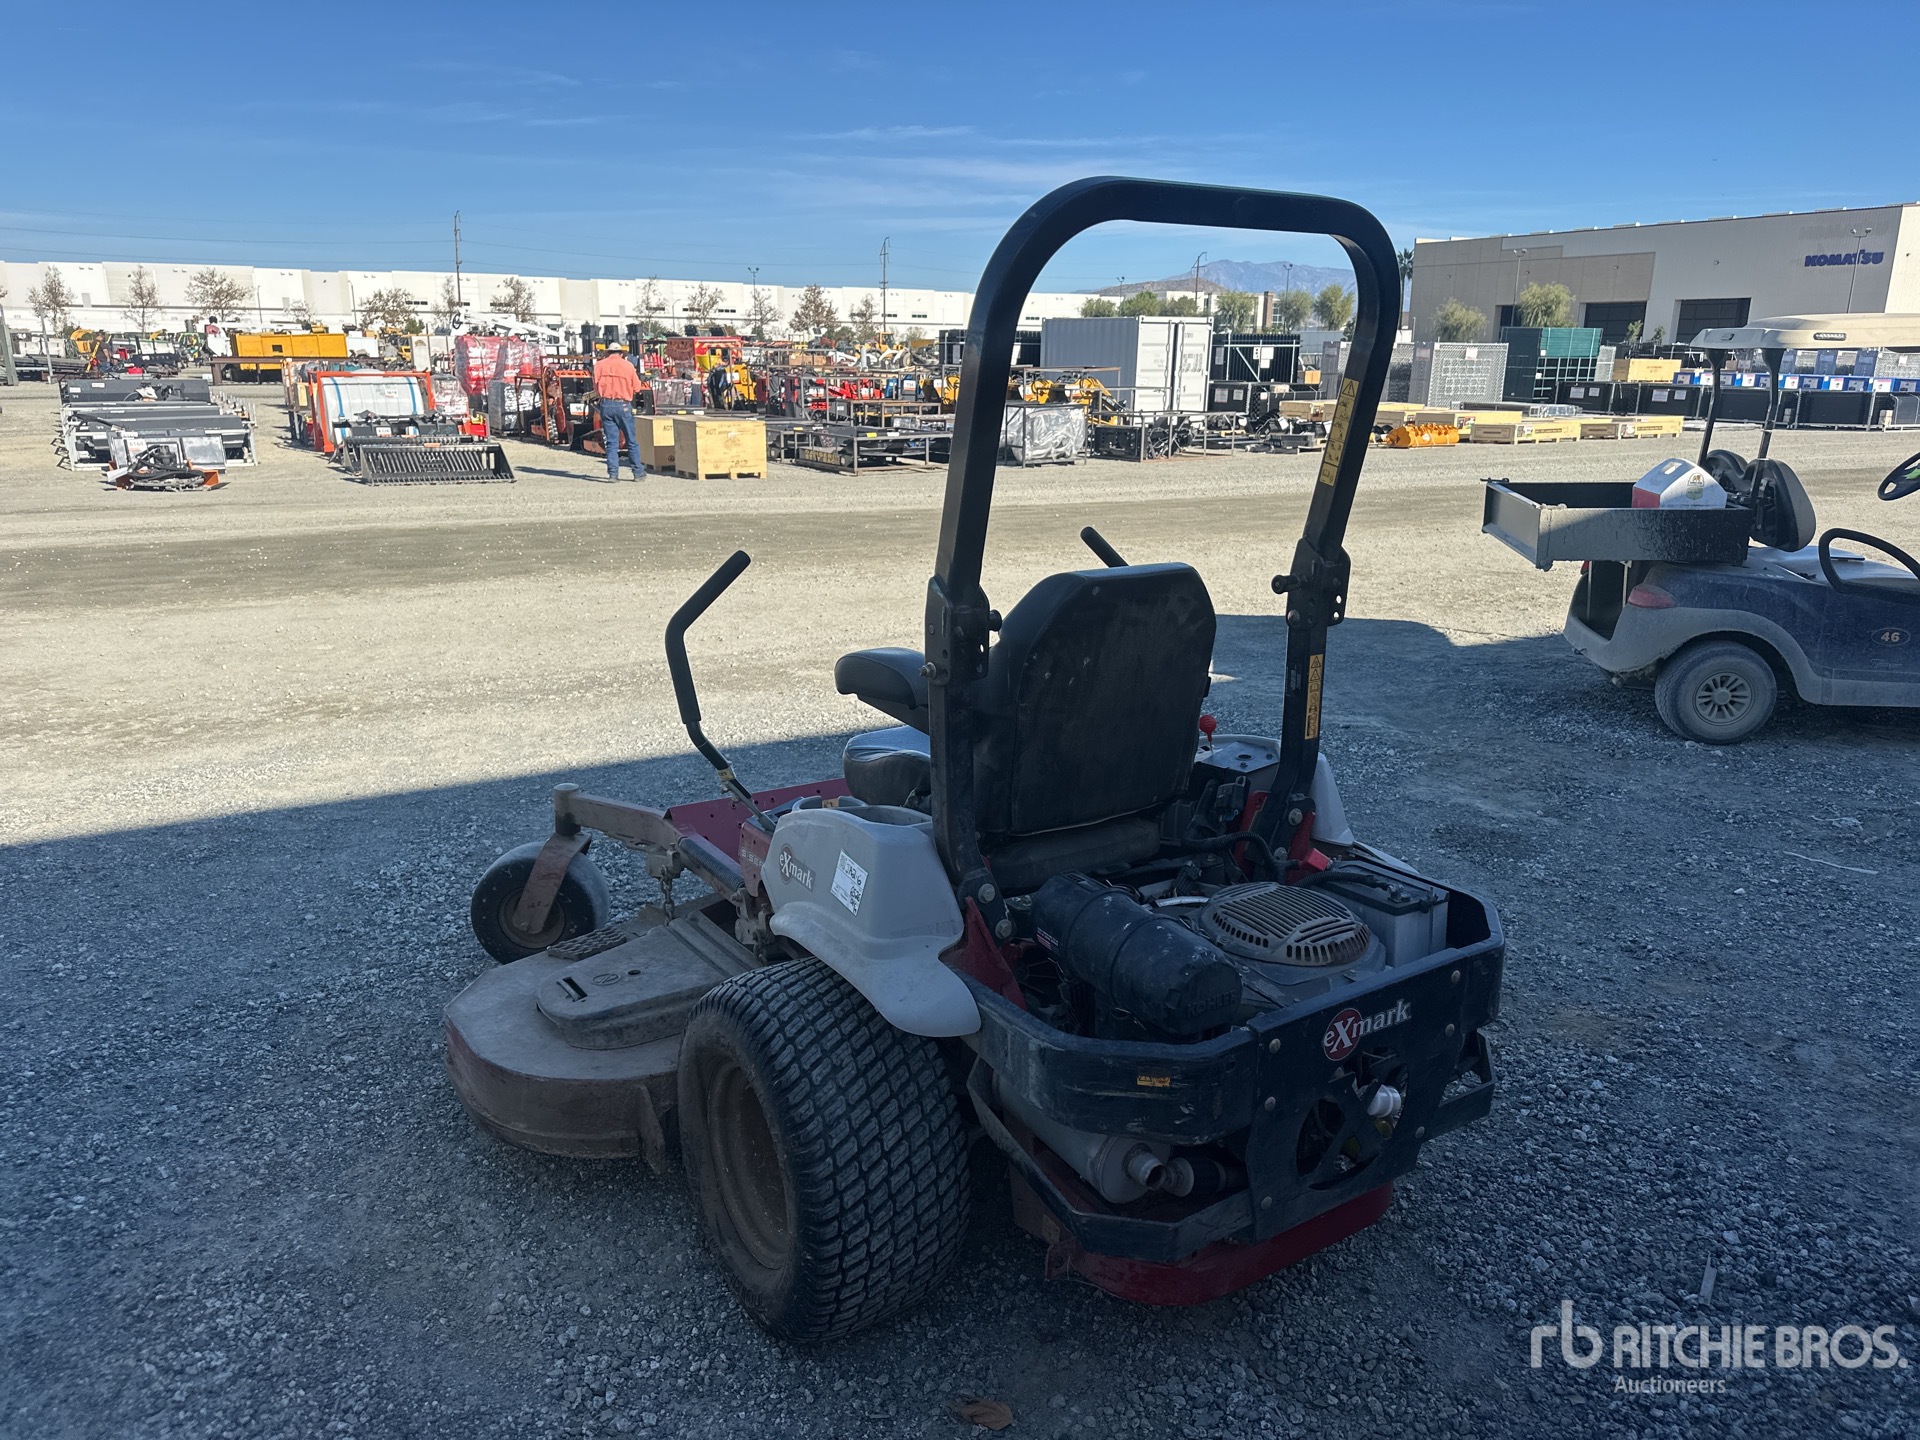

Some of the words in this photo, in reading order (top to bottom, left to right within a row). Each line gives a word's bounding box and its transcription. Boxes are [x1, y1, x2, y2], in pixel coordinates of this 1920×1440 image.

[1804, 249, 1884, 267] KOMATSU
[1880, 631, 1900, 643] 46
[779, 851, 814, 889] eXmark
[1323, 998, 1412, 1054] eXmark
